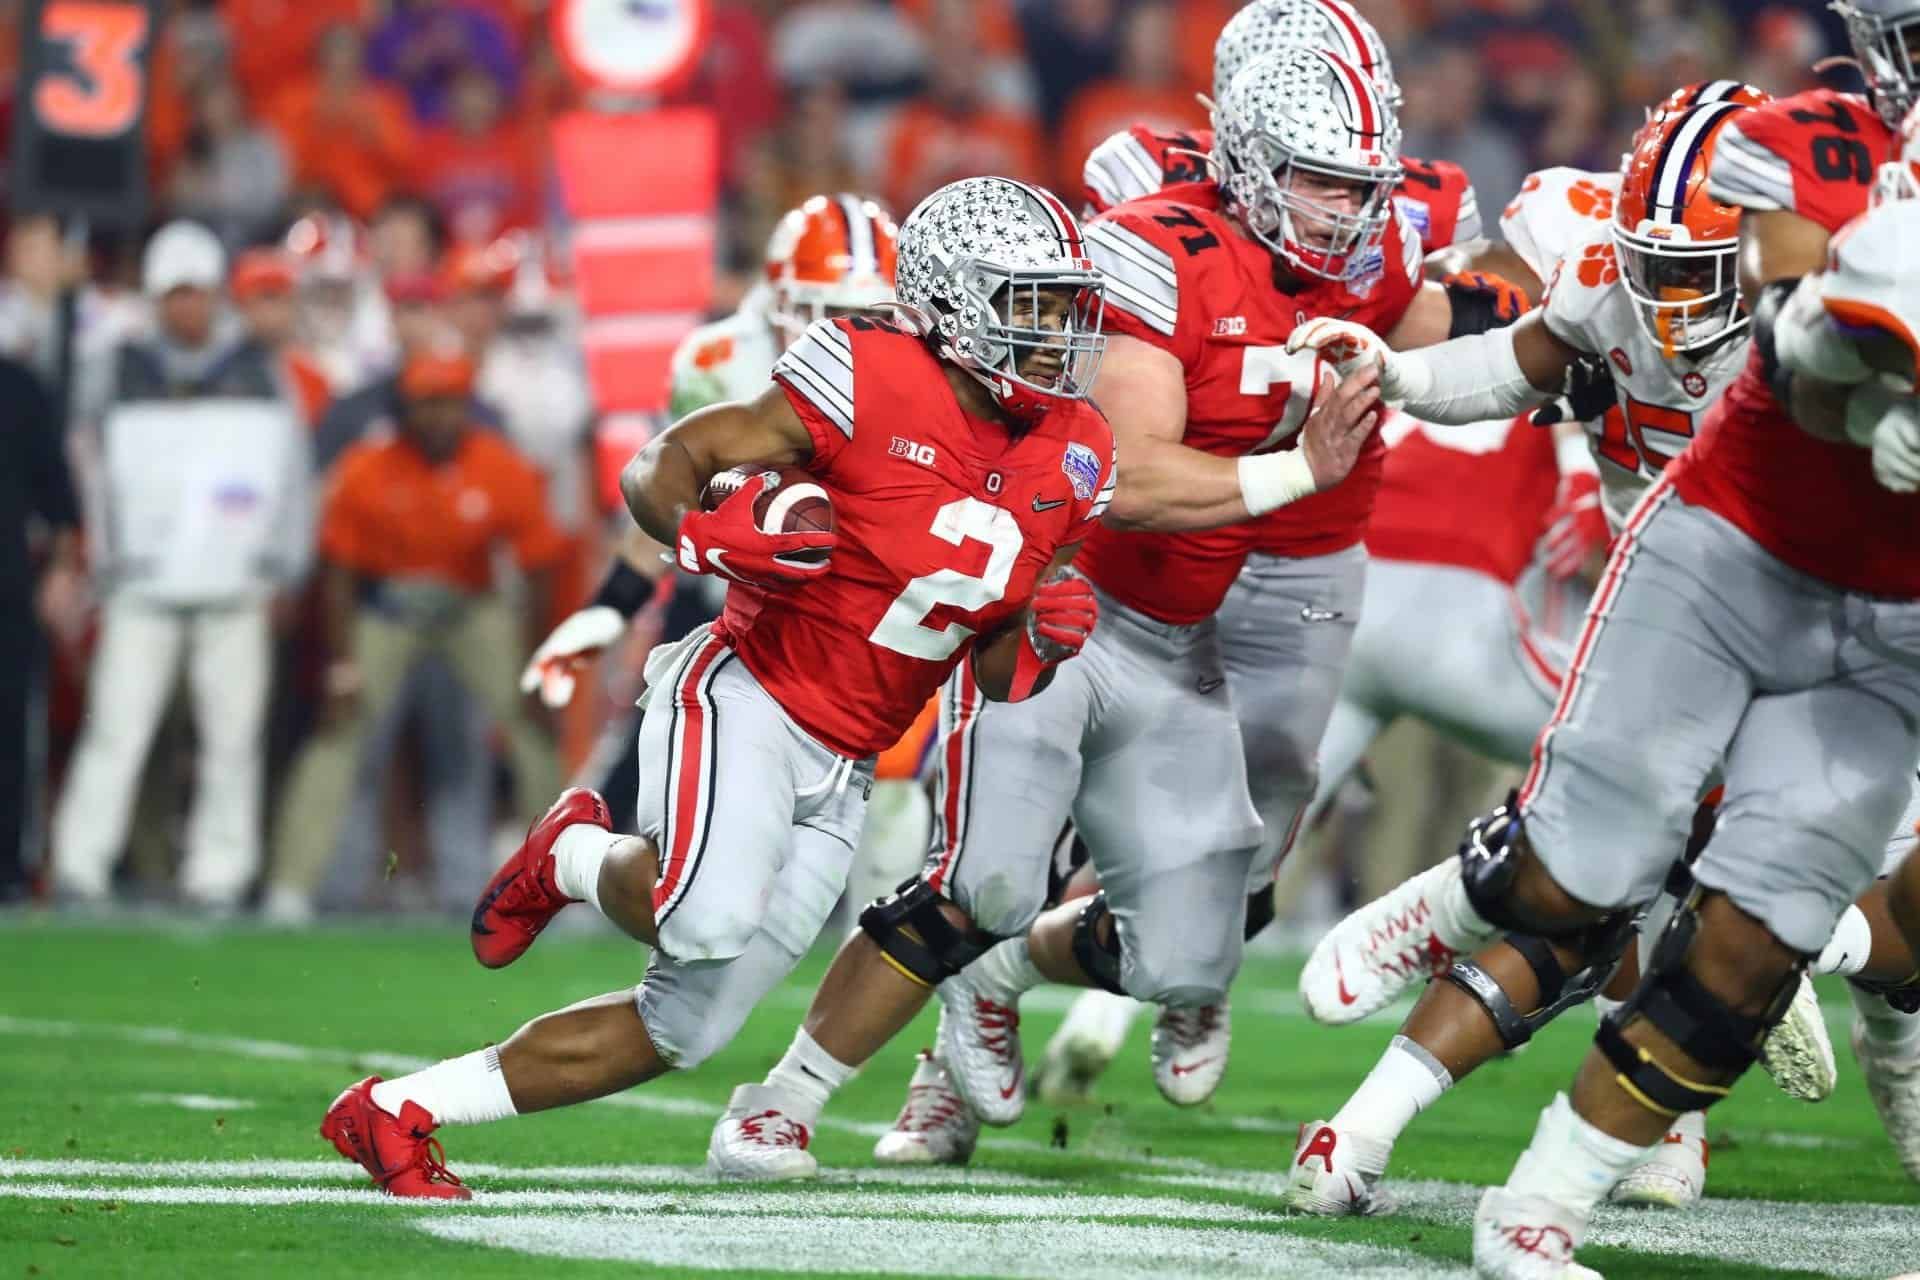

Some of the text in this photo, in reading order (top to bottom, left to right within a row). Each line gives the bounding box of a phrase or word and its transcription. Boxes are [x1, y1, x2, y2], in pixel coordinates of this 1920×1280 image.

[32, 2, 149, 136] 3
[1788, 101, 1873, 185] 76
[1152, 205, 1220, 256] 71
[1239, 343, 1343, 456] 7
[868, 496, 1024, 662] 2
